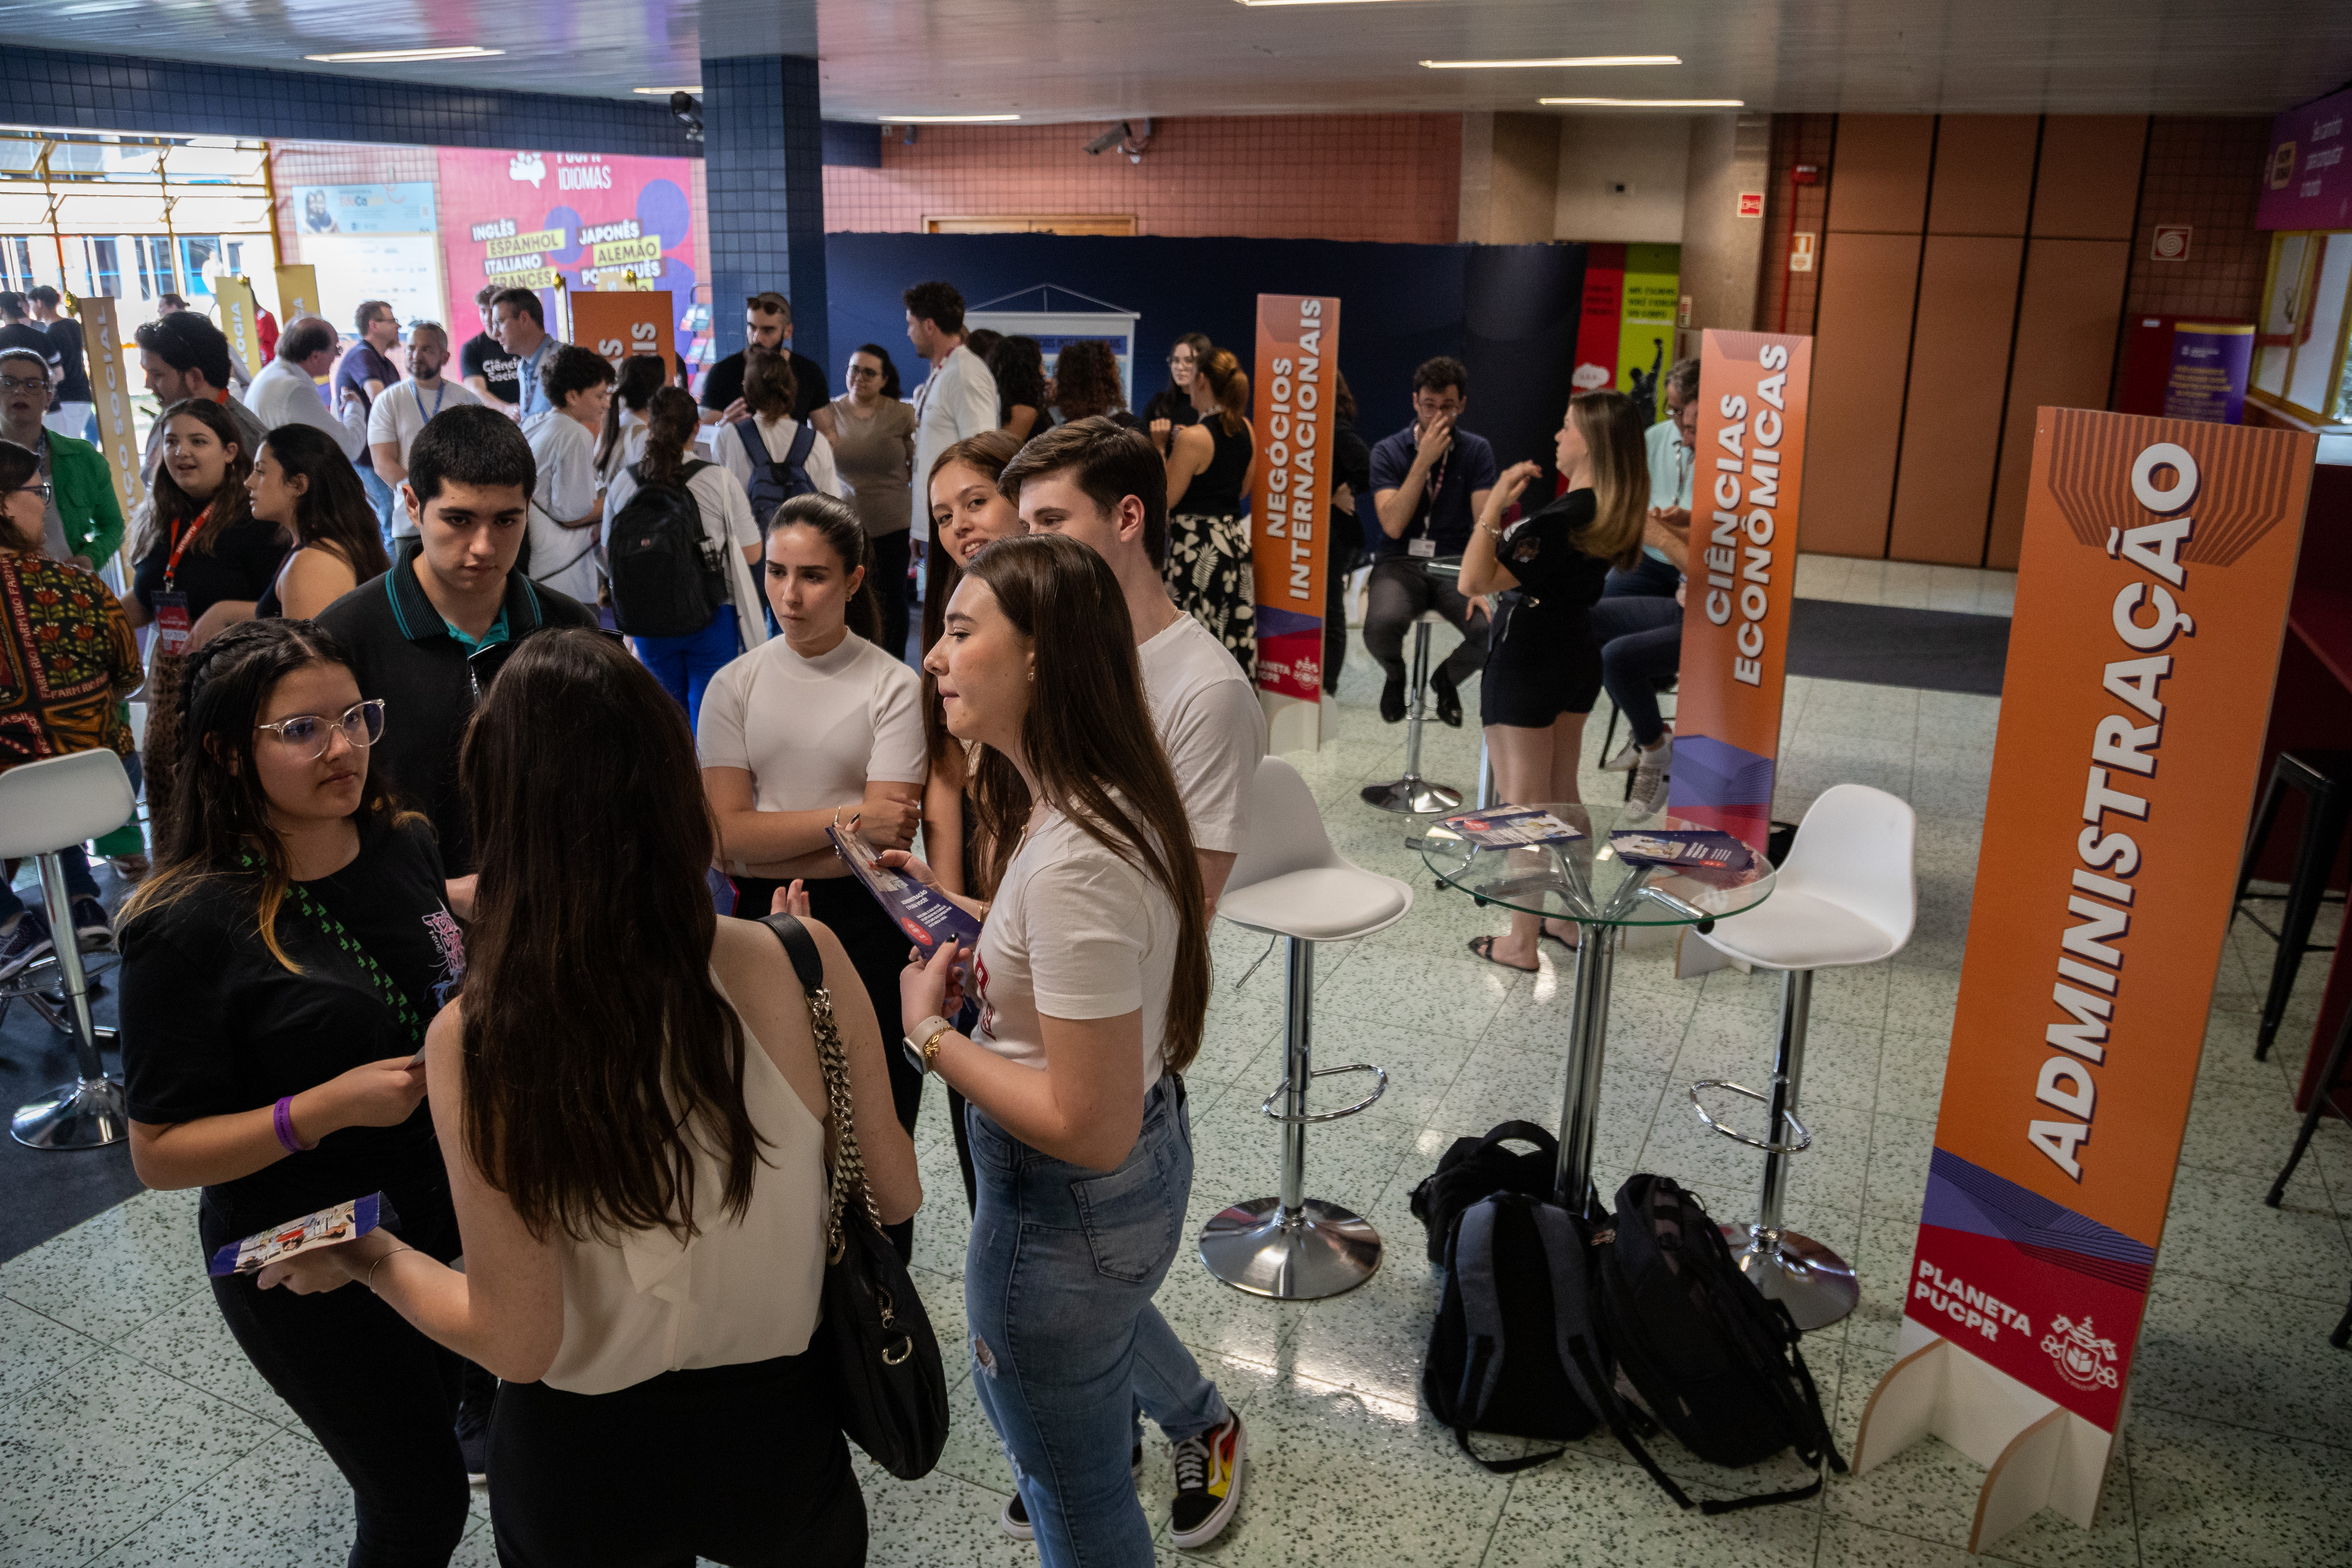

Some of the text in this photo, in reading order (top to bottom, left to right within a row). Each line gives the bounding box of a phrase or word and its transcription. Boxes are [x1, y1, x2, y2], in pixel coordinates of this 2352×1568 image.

[558, 166, 612, 190] IDIOMAS
[472, 219, 516, 241] INGLÊS
[491, 233, 559, 256] ESPANHOL
[579, 219, 640, 245] JAPONÊS
[598, 240, 657, 263] ALEMÃO
[485, 255, 542, 275] ITALIANO
[97, 305, 125, 436] SOCIAL
[483, 357, 519, 374] Ciênci
[1264, 358, 1293, 538] NEGÓCIOS
[1289, 299, 1322, 600] INTERNACIONAIS
[1703, 394, 1748, 626] CIÊNCIAS
[1734, 344, 1788, 687] ECONÔMICAS
[0, 712, 34, 725] ASIL
[2028, 442, 2200, 1183] ADMINISTRAÇÃO
[1914, 1281, 1999, 1342] PUCPR
[1918, 1259, 2032, 1337] PLANETA
